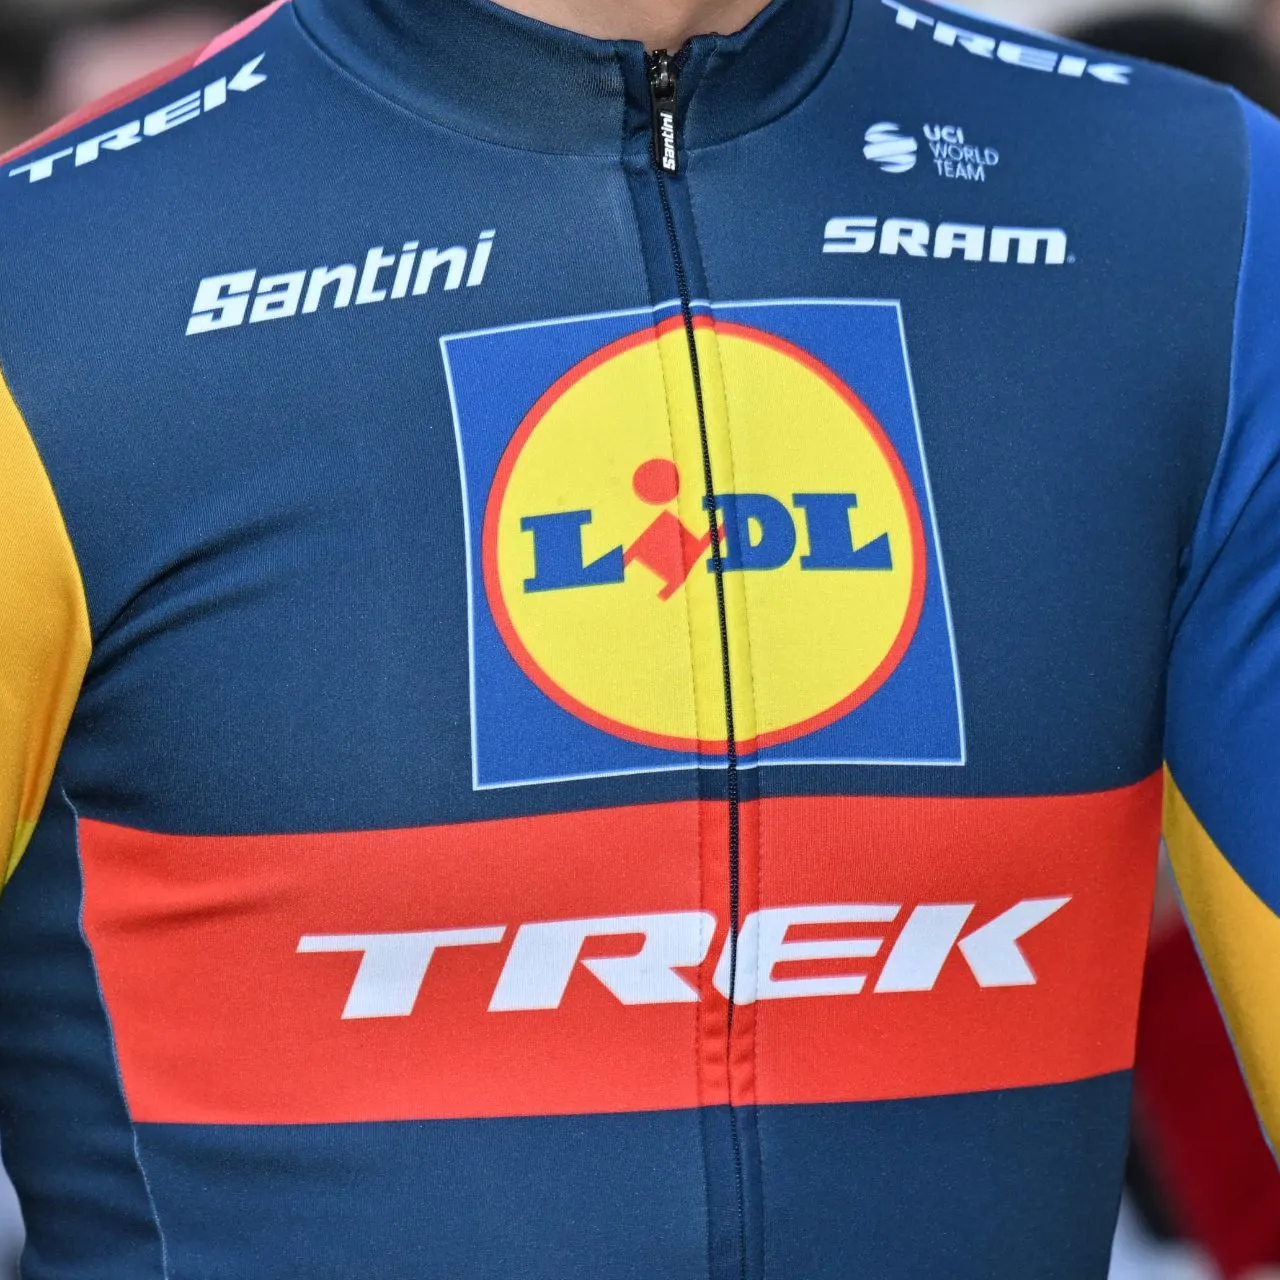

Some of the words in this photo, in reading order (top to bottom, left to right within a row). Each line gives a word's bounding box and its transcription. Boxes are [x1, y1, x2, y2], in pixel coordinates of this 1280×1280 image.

[9, 52, 268, 184] TREK
[660, 112, 676, 171] Santini
[923, 123, 964, 144] UCI
[929, 141, 1000, 166] WORLD
[933, 159, 987, 182] TEAM
[822, 216, 1068, 264] SRAM
[185, 229, 497, 336] Santini
[296, 897, 1072, 1020] TREK
